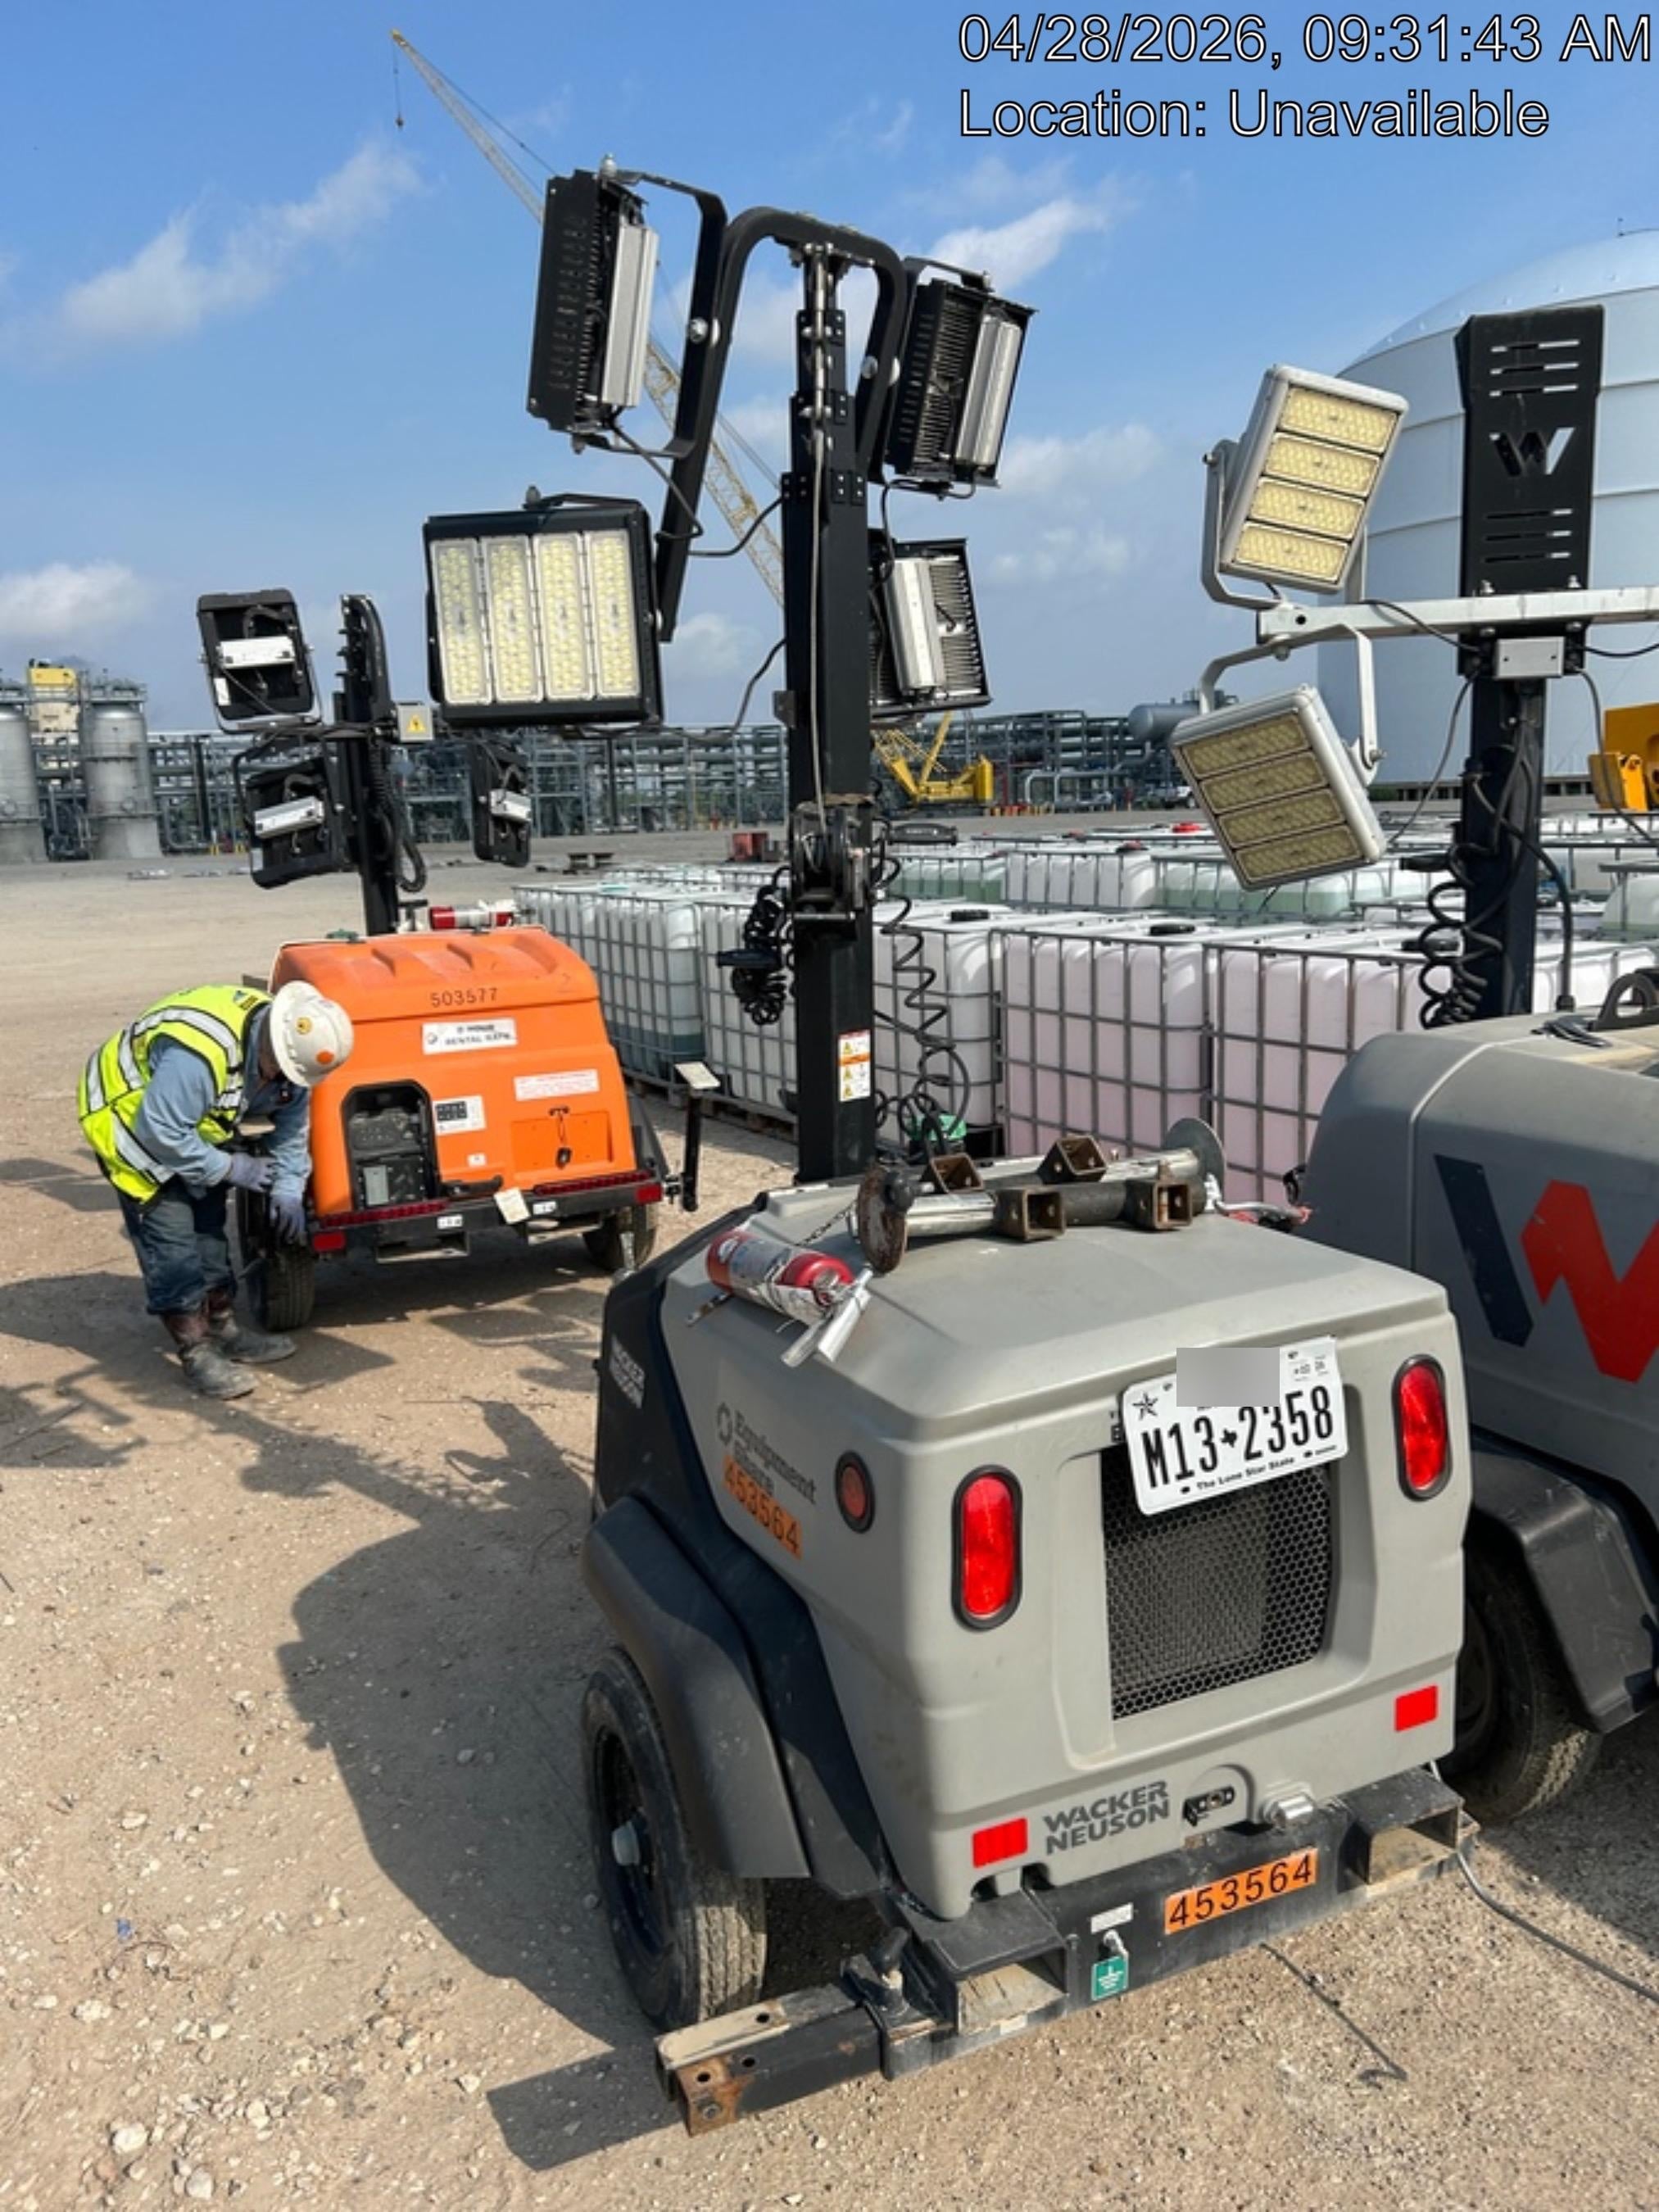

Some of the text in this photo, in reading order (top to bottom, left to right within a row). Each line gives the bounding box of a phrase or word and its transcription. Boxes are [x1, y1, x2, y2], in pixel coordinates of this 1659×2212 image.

[430, 988, 498, 1008] 503577
[724, 1461, 800, 1554] 453564
[1043, 1780, 1169, 1833] WACKER
[1046, 1798, 1170, 1856] NEUSON
[1169, 1854, 1312, 1926] 453564
